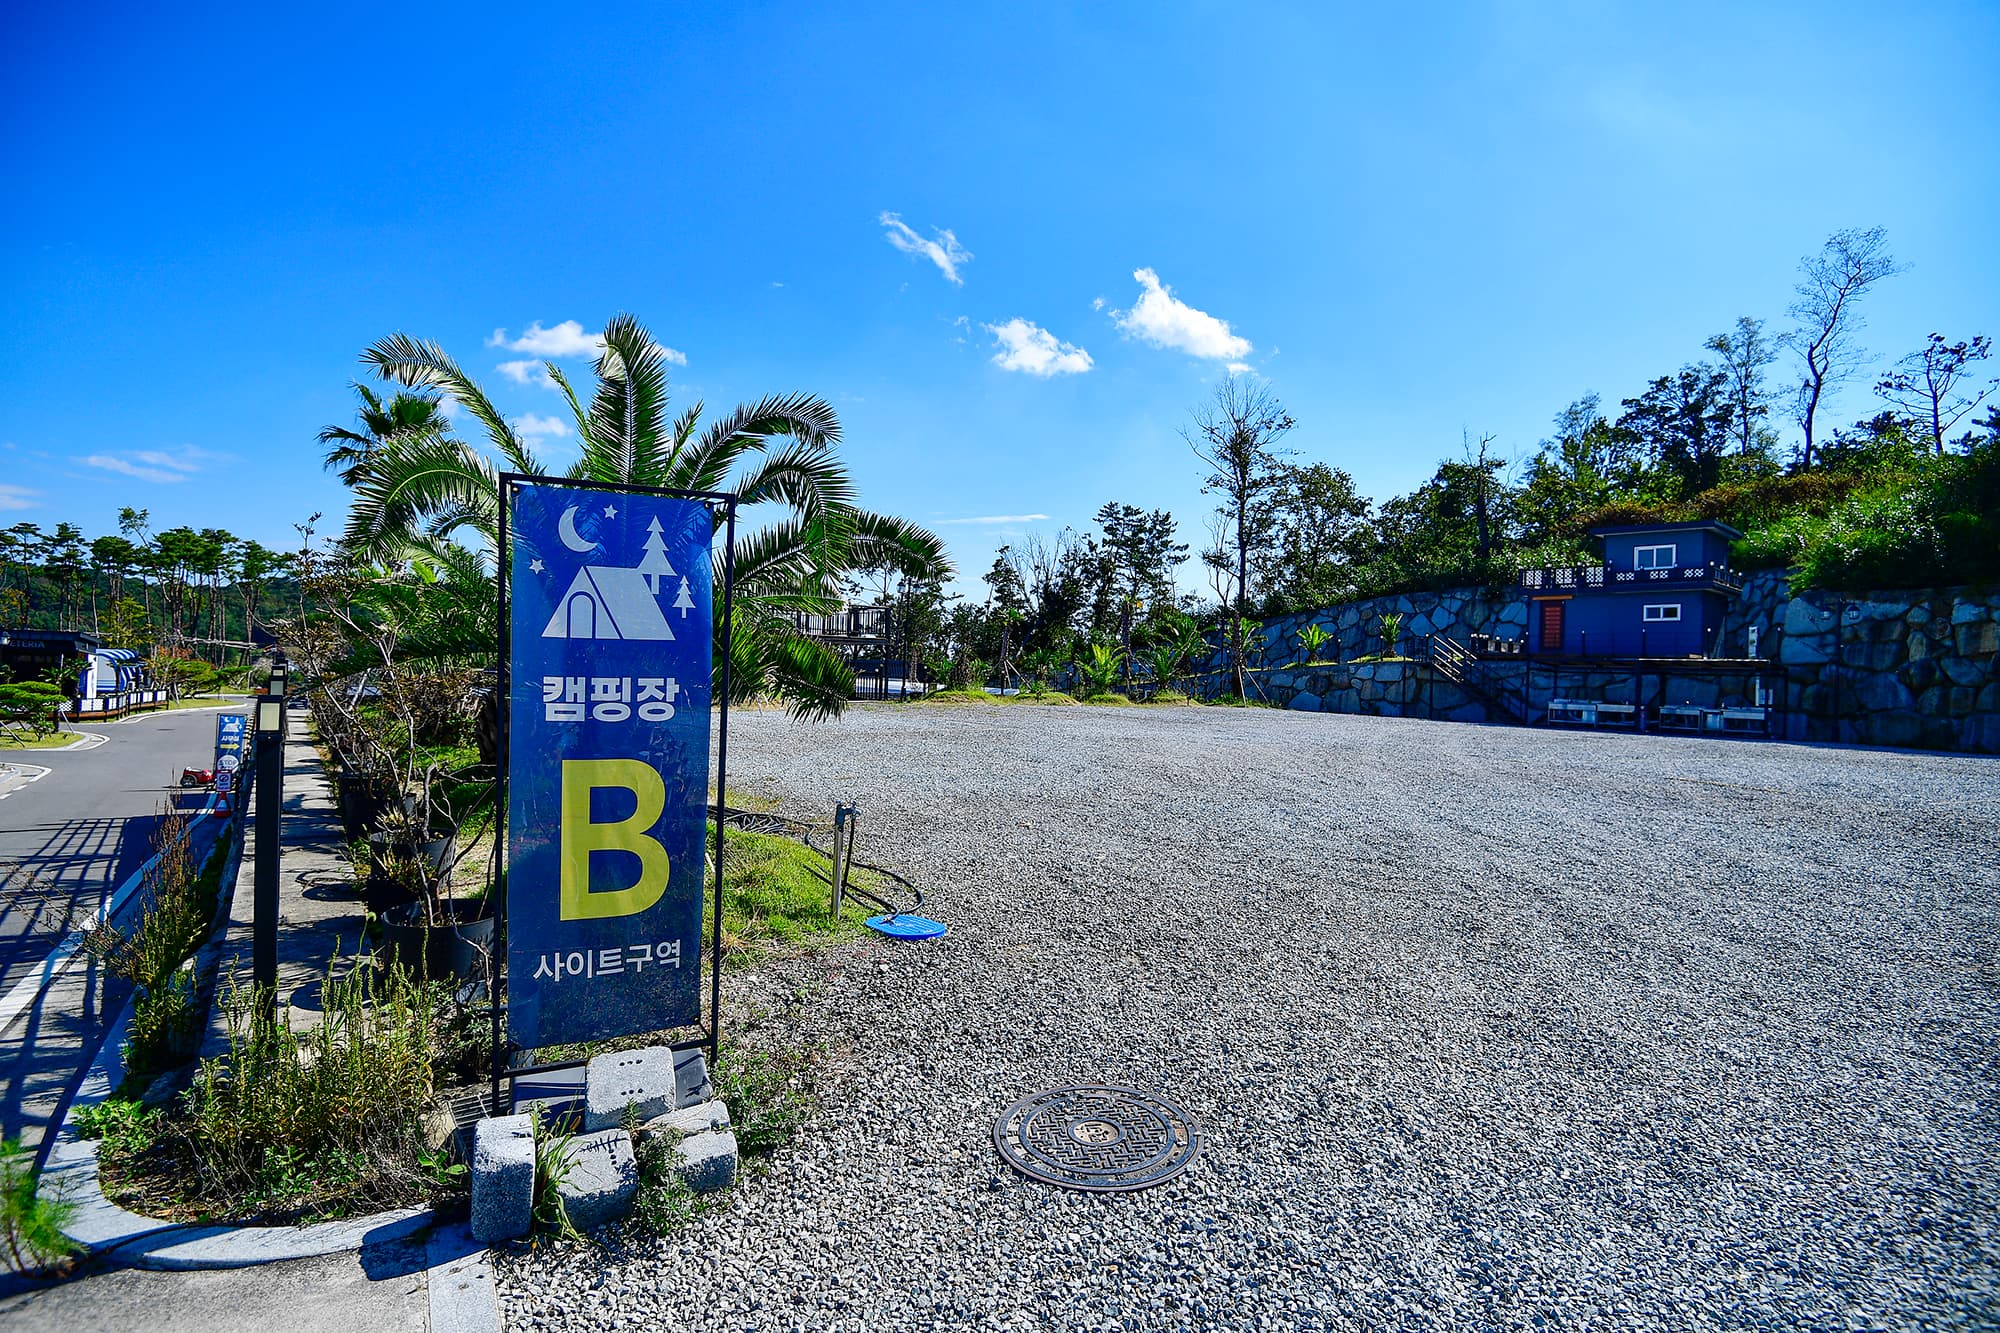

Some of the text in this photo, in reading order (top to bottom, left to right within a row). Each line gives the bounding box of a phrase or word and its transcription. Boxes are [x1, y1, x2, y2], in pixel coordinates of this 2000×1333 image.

[542, 676, 680, 722] 캠핑장
[559, 758, 671, 922] B
[532, 938, 682, 983] 사이트구역
